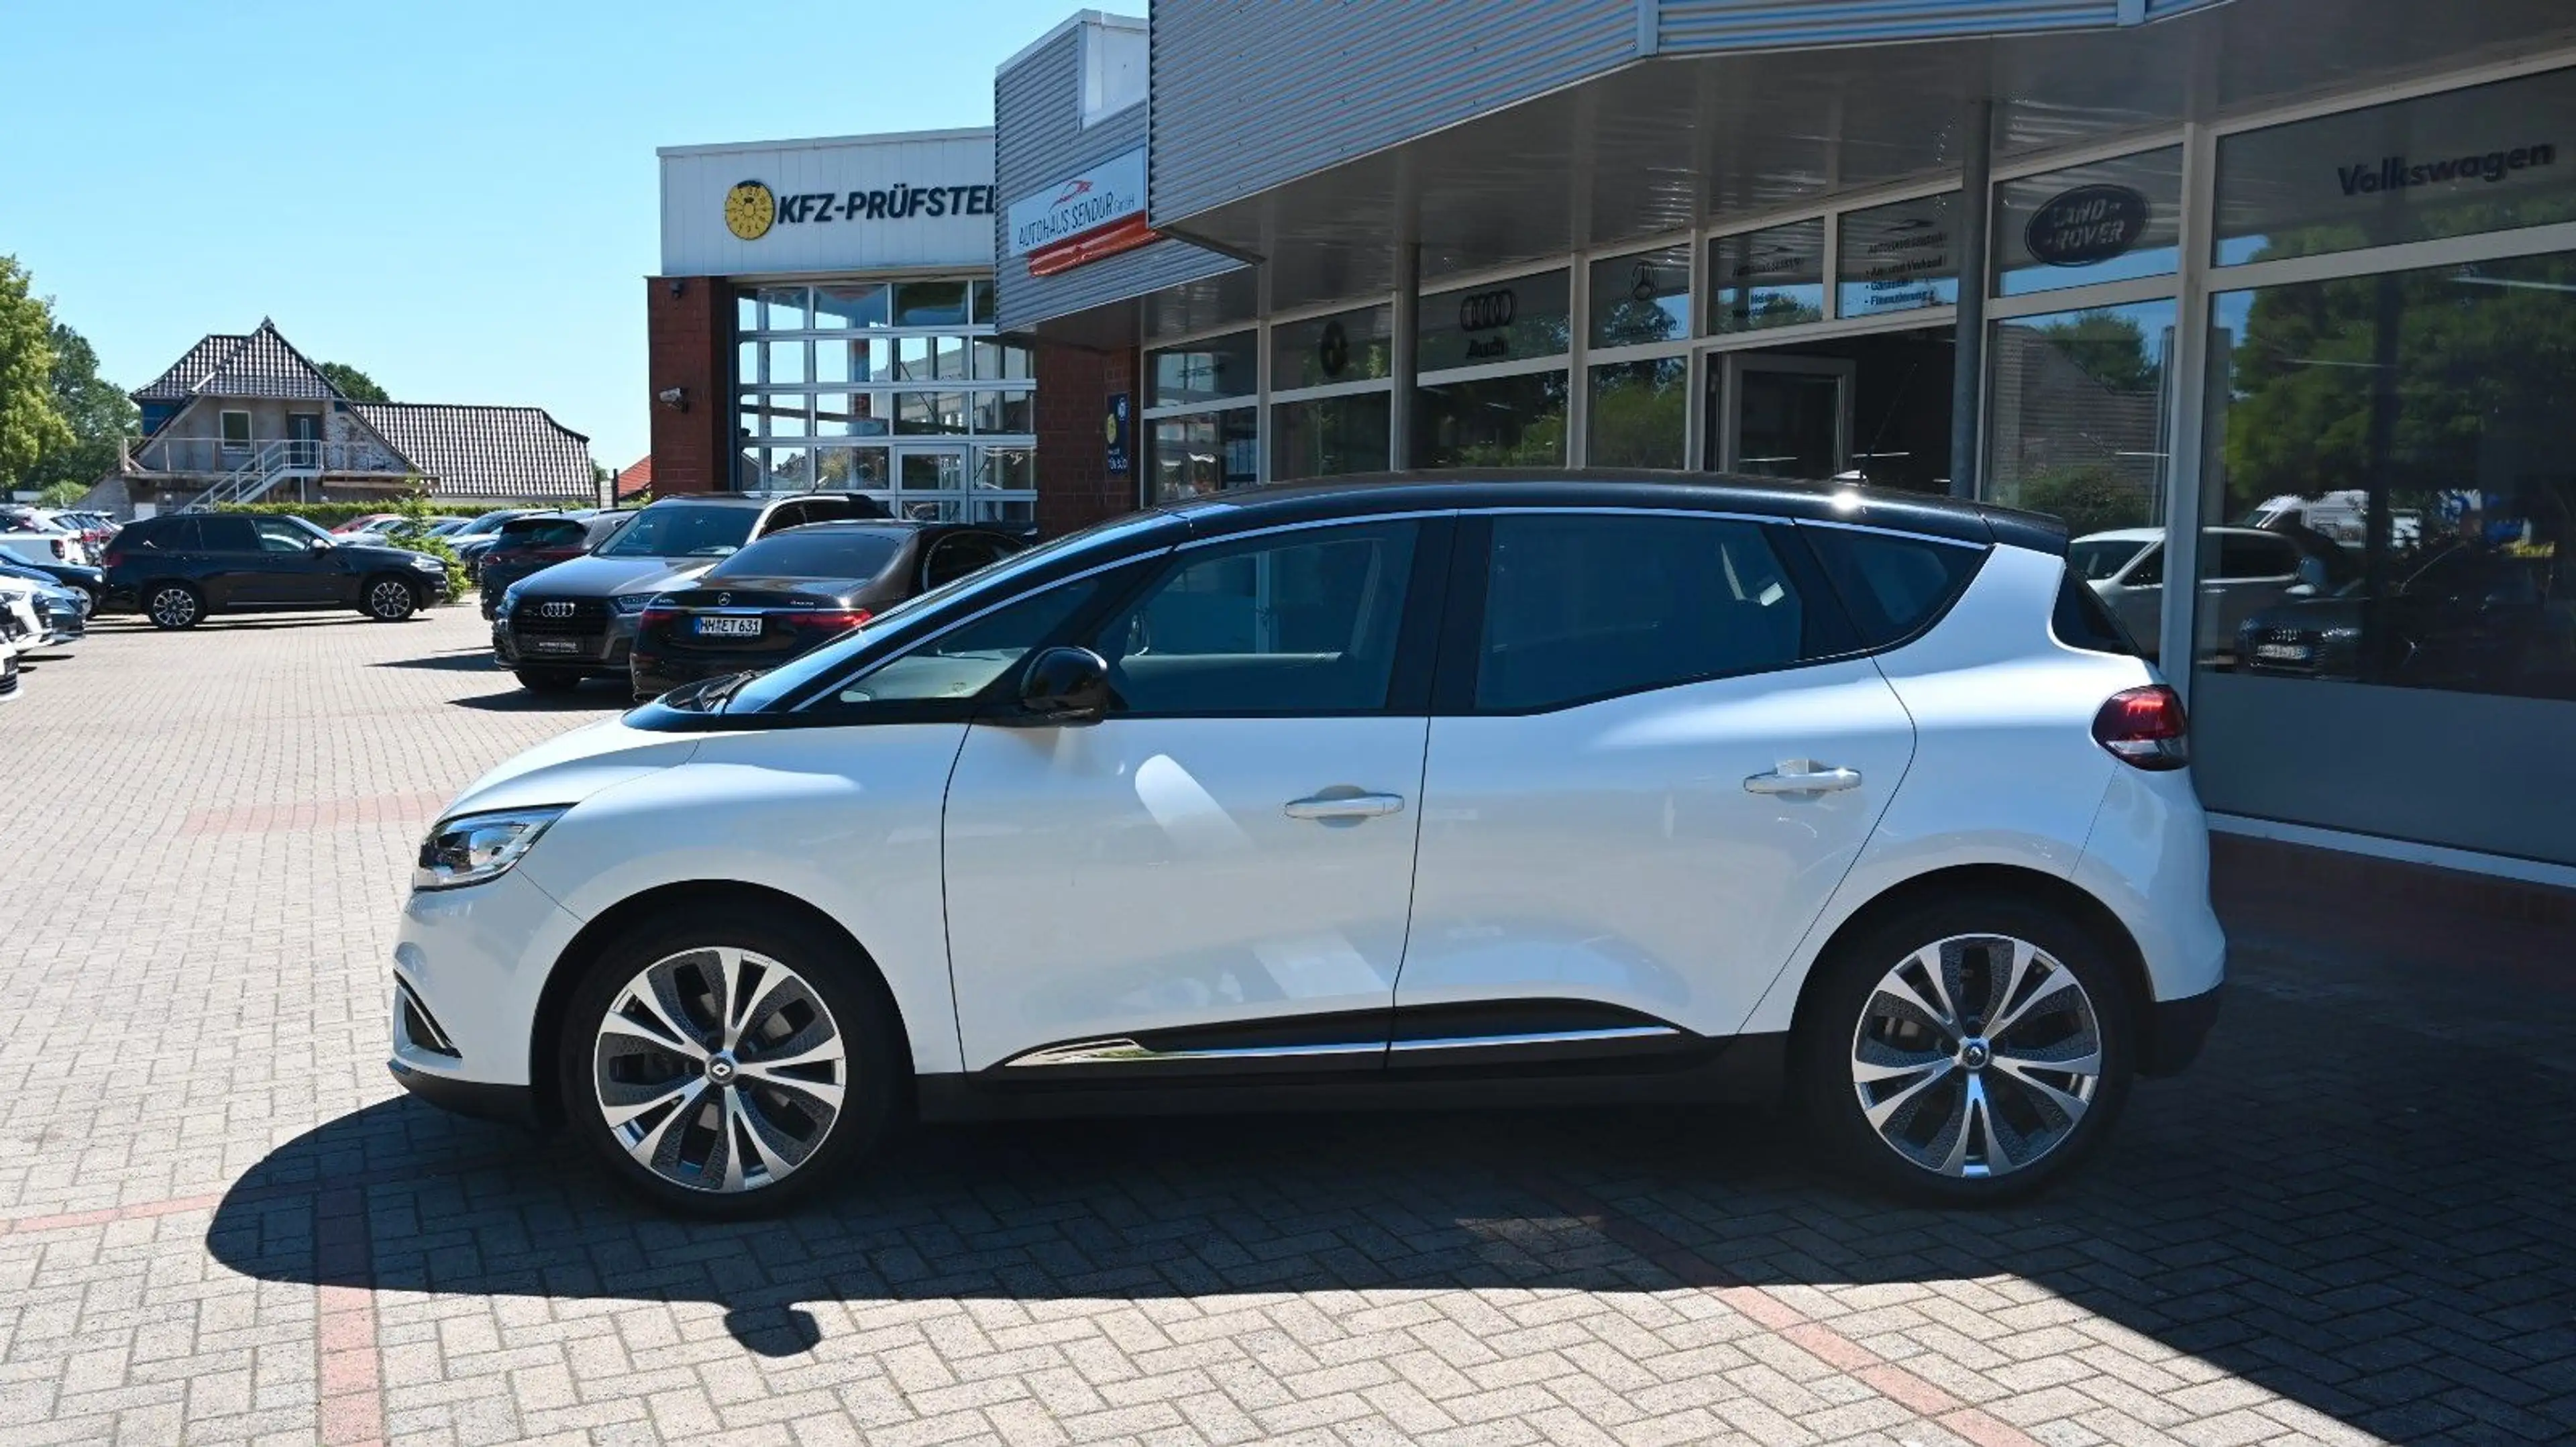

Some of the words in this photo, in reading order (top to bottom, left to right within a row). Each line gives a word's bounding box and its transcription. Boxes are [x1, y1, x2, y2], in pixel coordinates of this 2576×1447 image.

[2338, 144, 2556, 196] Volkswagen
[1019, 209, 1069, 247] AUTOHAUS
[2054, 199, 2108, 228] LAND
[2055, 219, 2125, 250] ROVER
[1466, 335, 1507, 360] Audi
[721, 619, 737, 632] ET
[739, 619, 759, 633] 631
